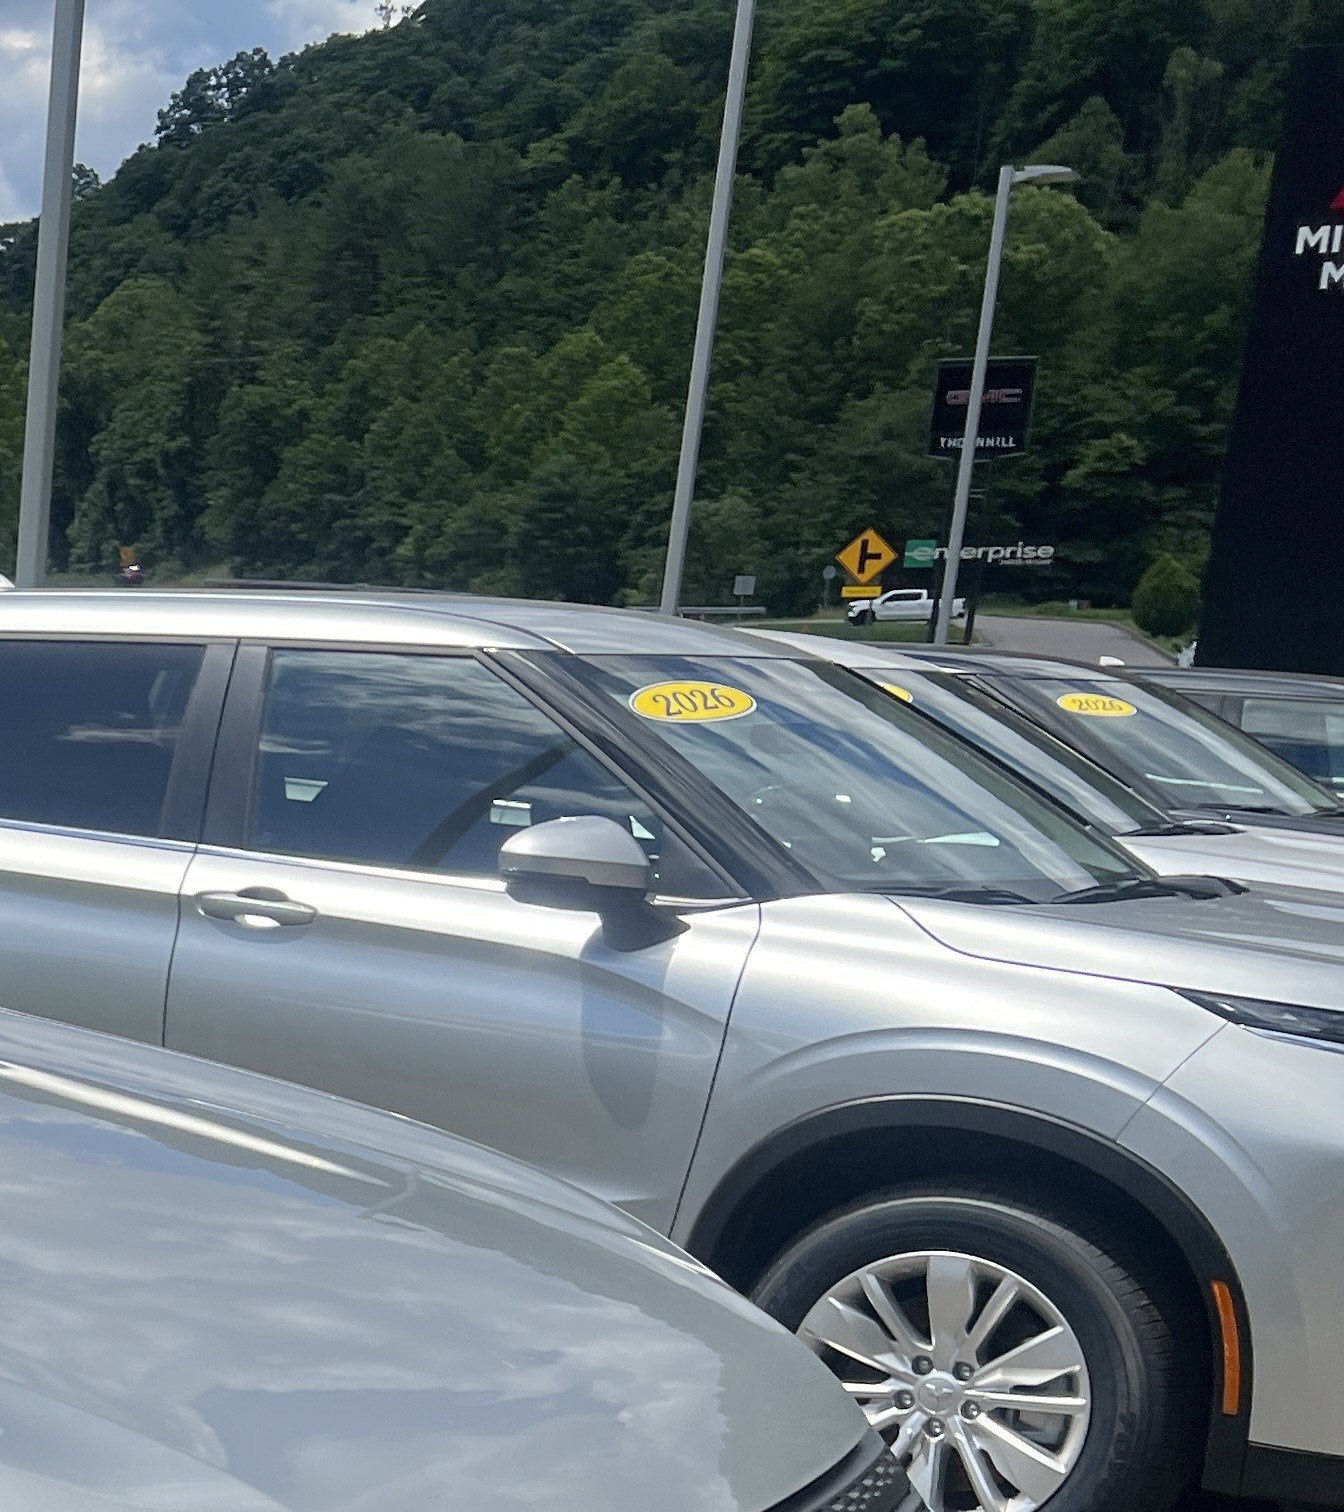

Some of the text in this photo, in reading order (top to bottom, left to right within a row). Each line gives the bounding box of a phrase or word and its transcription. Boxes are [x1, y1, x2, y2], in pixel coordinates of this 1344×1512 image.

[940, 436, 1016, 448] THONHILL
[912, 541, 1055, 563] enerprise
[653, 687, 736, 716] 2026
